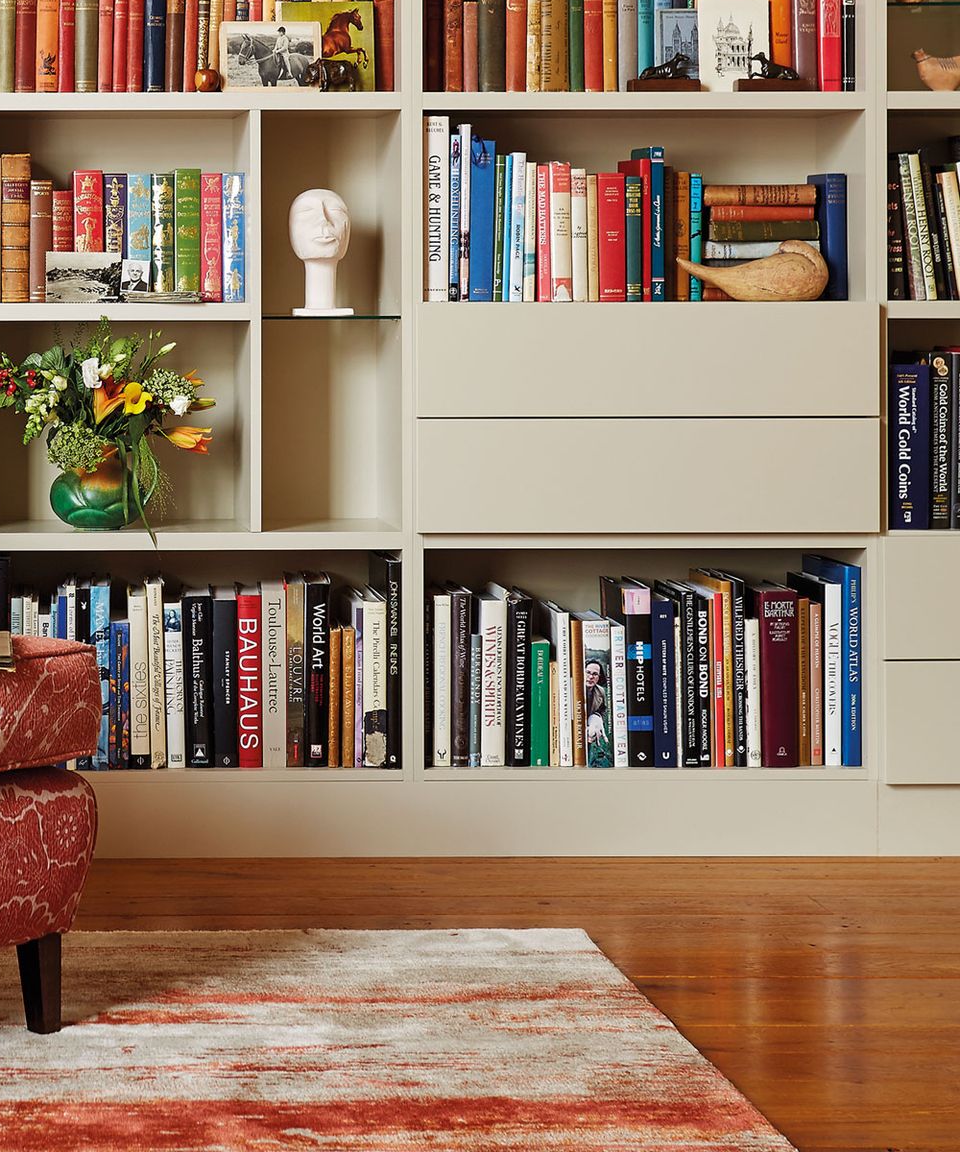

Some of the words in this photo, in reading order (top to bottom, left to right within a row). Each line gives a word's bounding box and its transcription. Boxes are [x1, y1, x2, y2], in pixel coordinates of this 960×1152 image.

[428, 155, 441, 189] GAME
[428, 193, 441, 203] &
[902, 177, 914, 220] HENRY
[429, 207, 441, 262] HUNTING
[907, 220, 919, 251] ROOT
[918, 210, 928, 249] HENRY
[922, 250, 934, 279] ROOT
[898, 386, 910, 424] World
[939, 384, 947, 405] Gold
[939, 407, 948, 433] Coins
[898, 429, 911, 460] Gold
[939, 434, 948, 445] of
[940, 446, 948, 462] the
[898, 464, 910, 499] Coins
[939, 463, 948, 492] World
[312, 603, 325, 645] World
[372, 621, 380, 635] The
[686, 607, 694, 652] GENTLEMEN'S
[698, 610, 707, 645] BOND
[735, 597, 743, 641] WILFRED
[849, 607, 858, 648] WORLD
[372, 638, 380, 660] Pirelli
[485, 625, 495, 668] WINES
[517, 620, 526, 654] GREAT
[614, 635, 624, 668] RIVER
[635, 641, 643, 664] HIP
[700, 647, 707, 661] ON
[828, 623, 839, 659] VOGUE
[152, 647, 161, 672] Beautiful
[192, 639, 202, 678] Balthus
[268, 599, 281, 713] Toulouse-Lautrec
[312, 648, 327, 669] Art
[736, 642, 744, 690] THESIGER
[828, 662, 836, 680] THE
[849, 650, 858, 682] ATLAS
[132, 662, 147, 708] sixties
[151, 674, 161, 696] Villages
[166, 659, 175, 715] PAINTING
[239, 618, 258, 749] BAUHAUS
[292, 647, 302, 702] LOUVRE
[372, 662, 380, 698] Calendars
[485, 670, 494, 679] &
[515, 656, 525, 711] BORDEAUX
[636, 666, 644, 702] HOTELS
[688, 676, 694, 686] OF
[699, 664, 708, 697] BOND
[177, 703, 183, 713] OF
[485, 681, 495, 727] SPIRITS
[616, 676, 625, 726] COTTAGE
[135, 713, 147, 739] the
[515, 712, 524, 747] WINES
[617, 736, 626, 763] YEAR
